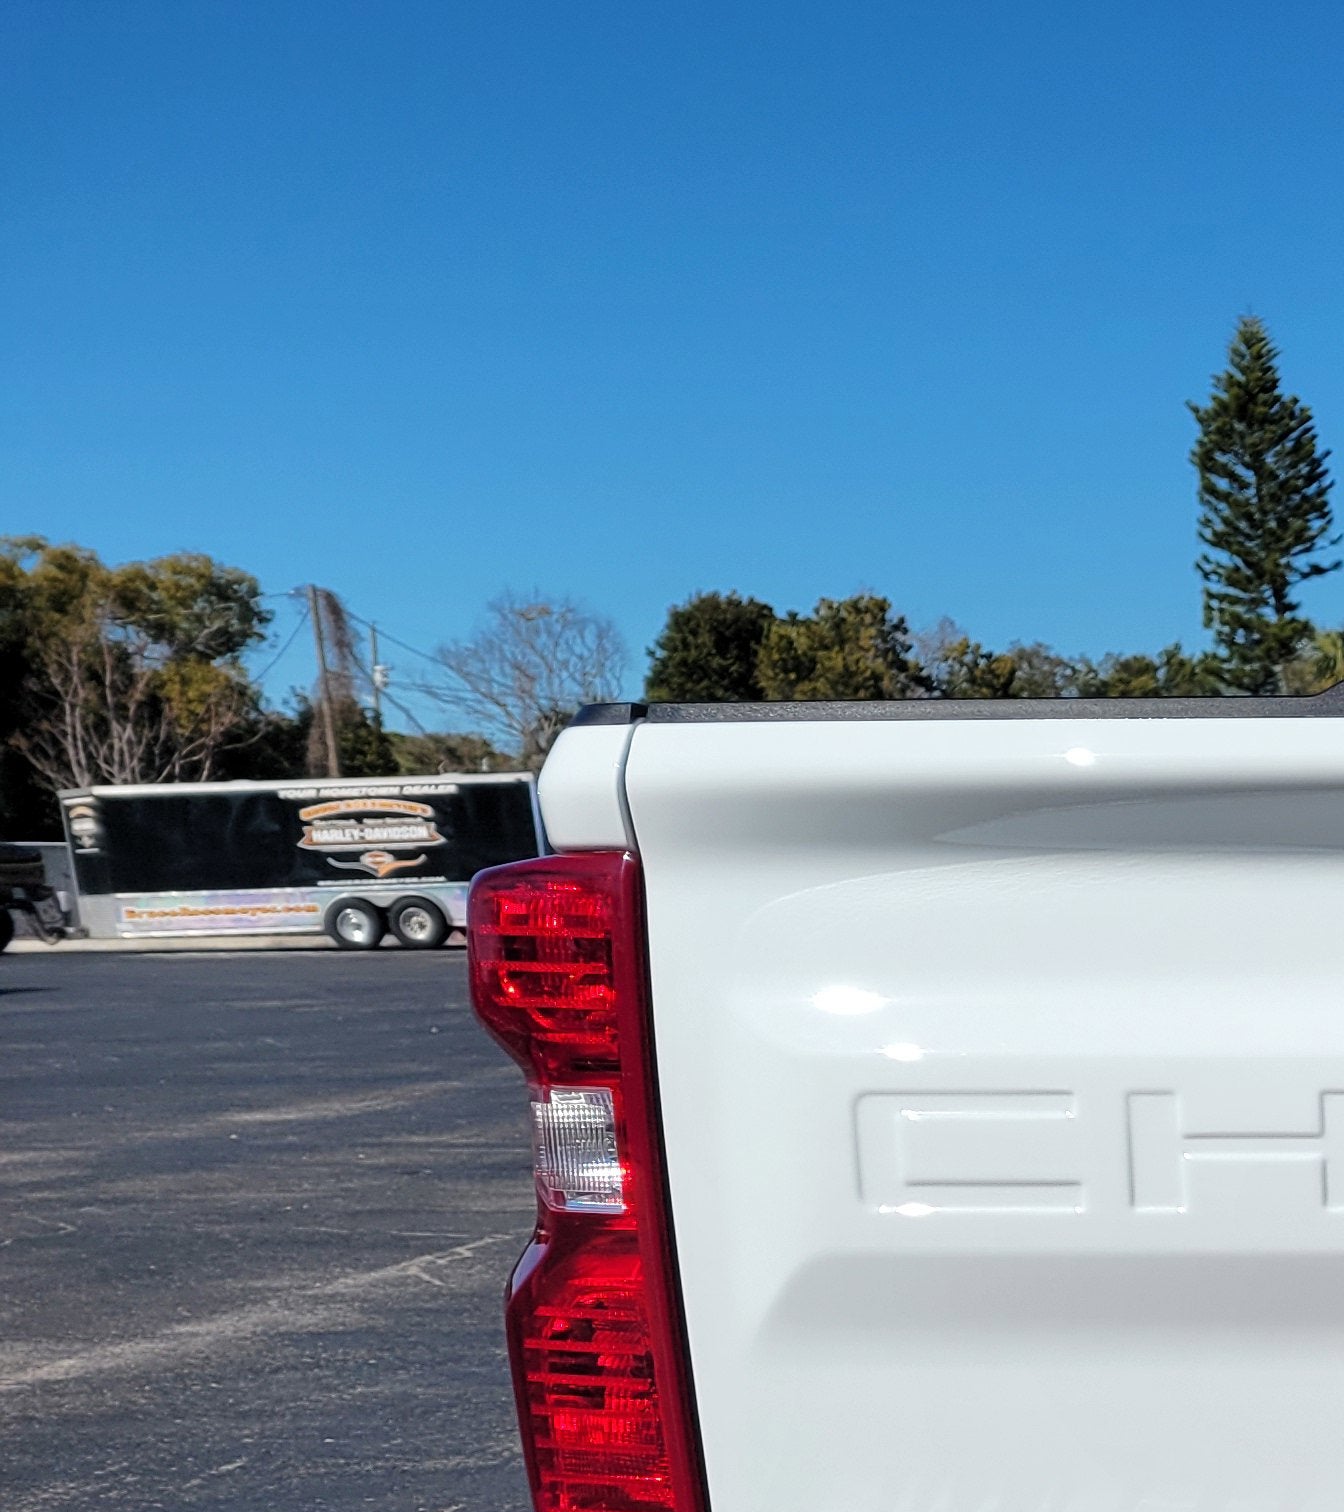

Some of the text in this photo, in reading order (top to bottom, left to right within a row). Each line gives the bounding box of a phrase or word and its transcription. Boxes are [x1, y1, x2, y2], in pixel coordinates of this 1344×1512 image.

[278, 784, 459, 799] YOUR HOMETOWN DEALER
[311, 826, 429, 842] HARLEY-DAVIDSON
